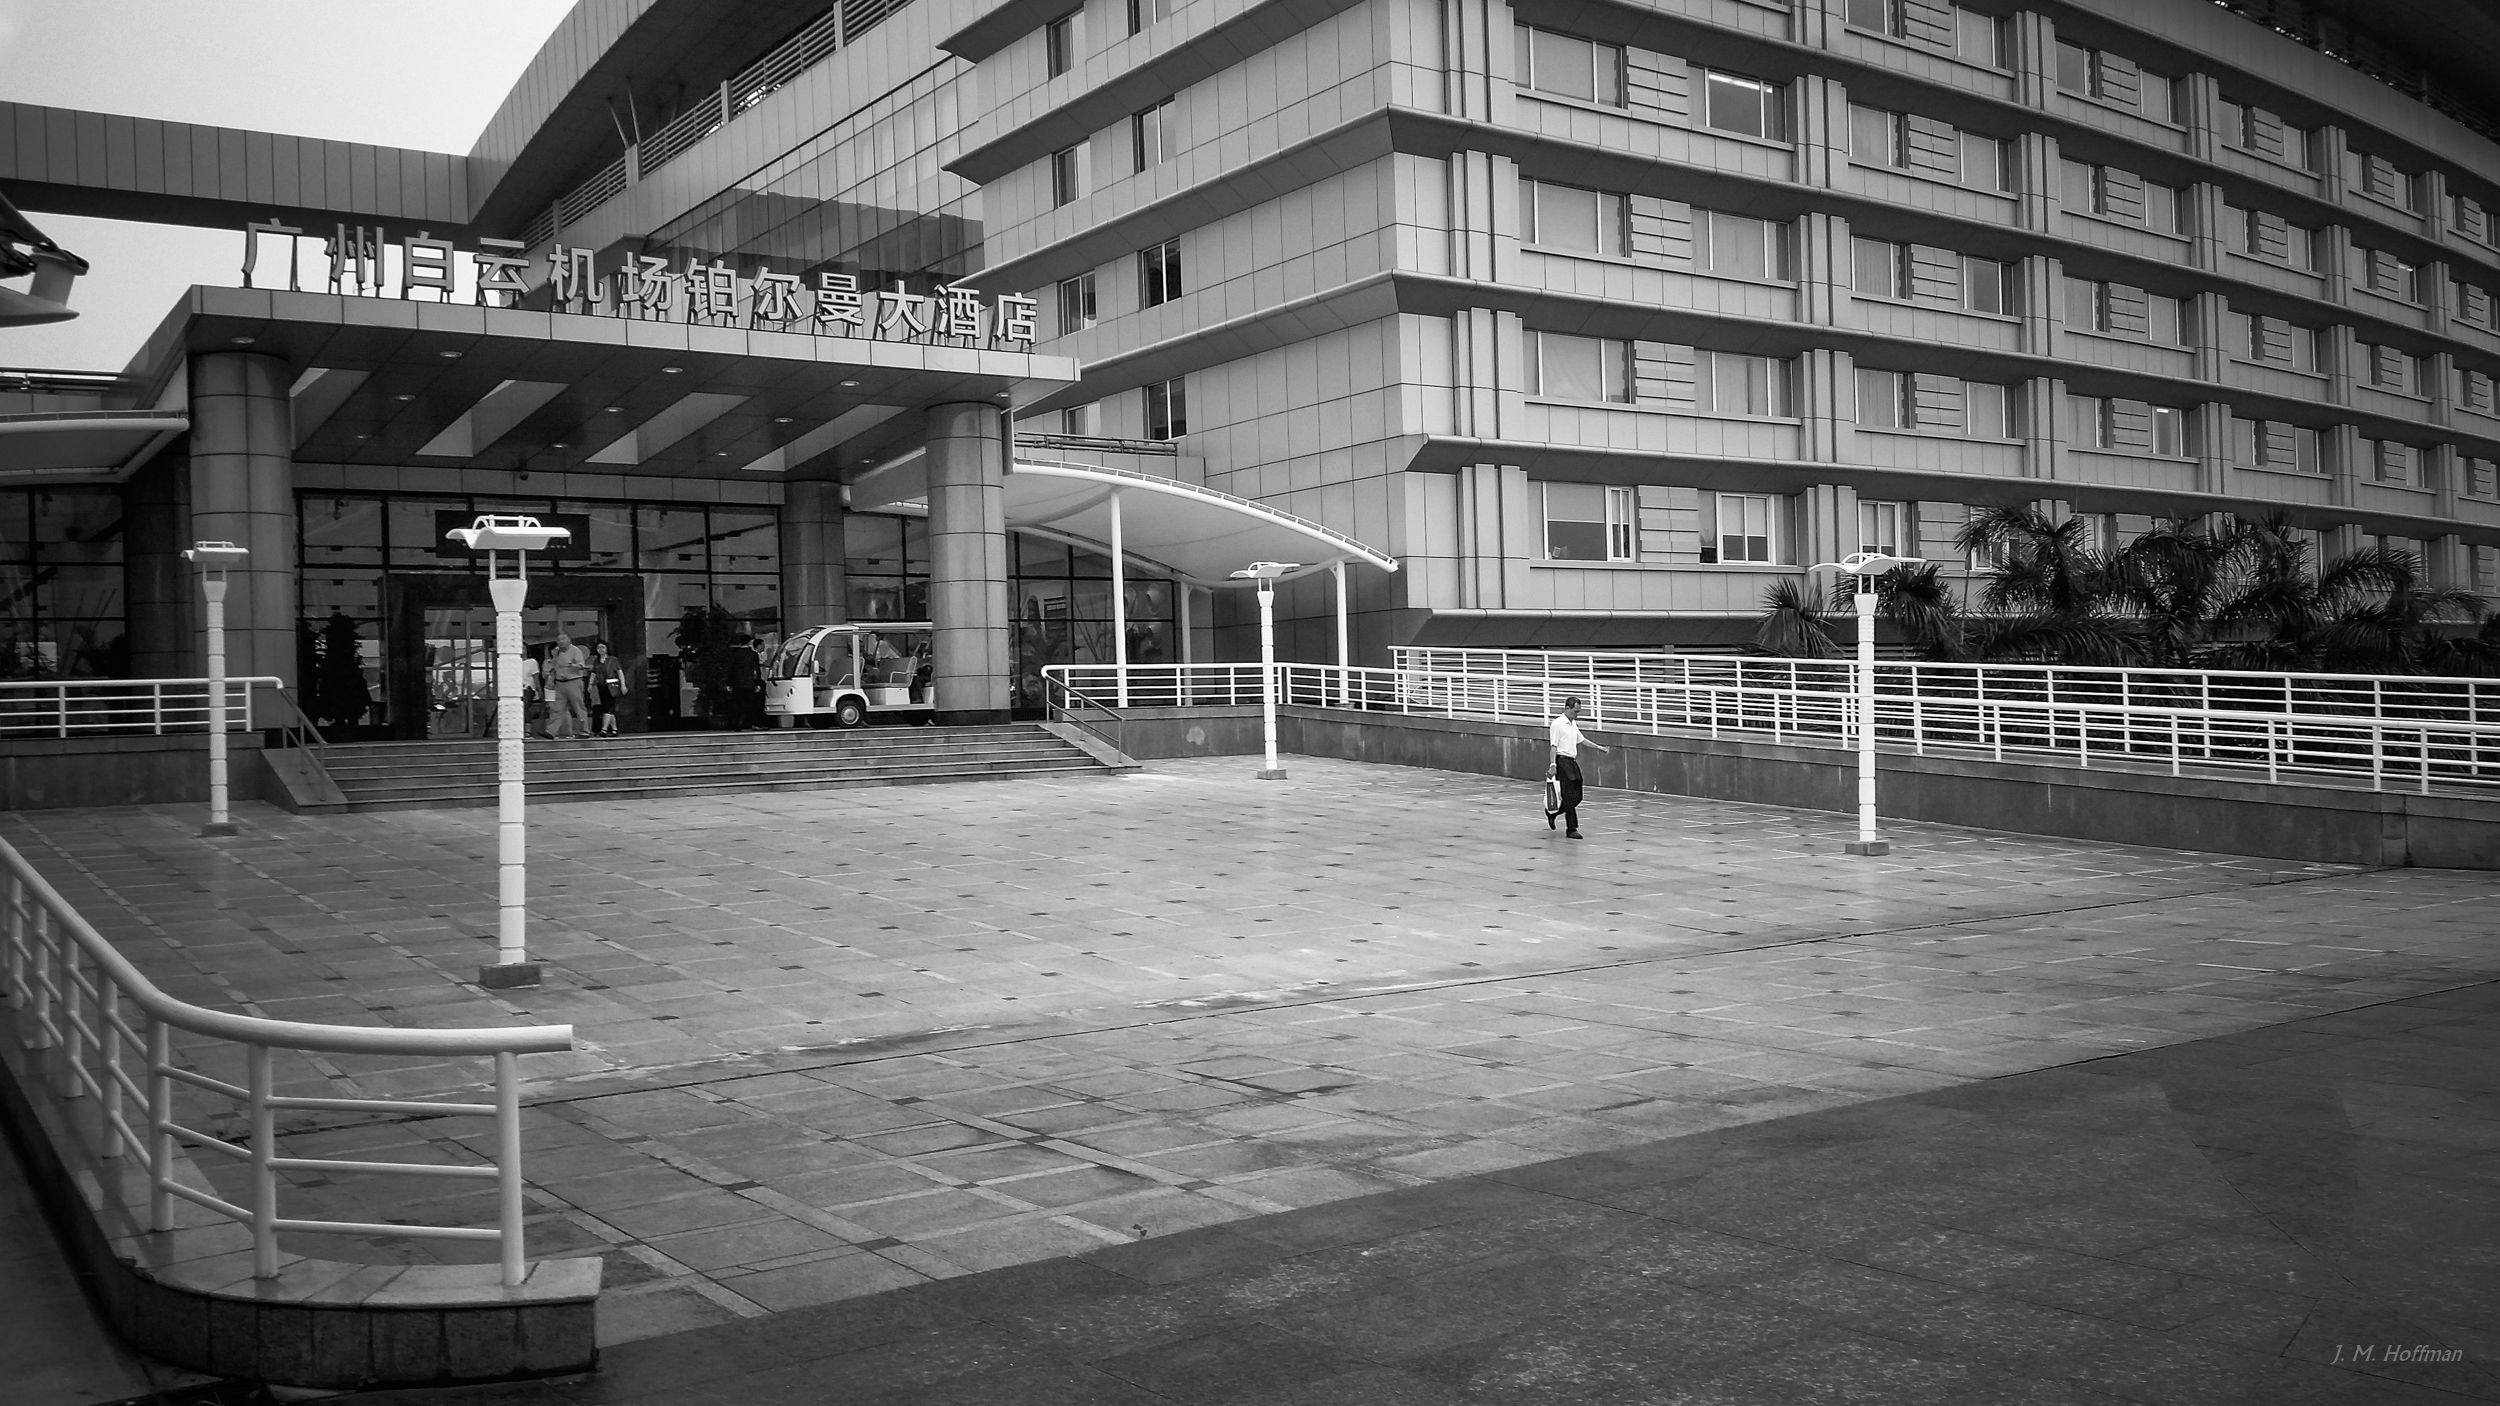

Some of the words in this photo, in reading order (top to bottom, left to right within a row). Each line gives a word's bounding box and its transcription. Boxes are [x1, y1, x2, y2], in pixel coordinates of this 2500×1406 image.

[242, 217, 1037, 343] 广州白云机场铂尔曼大酒店
